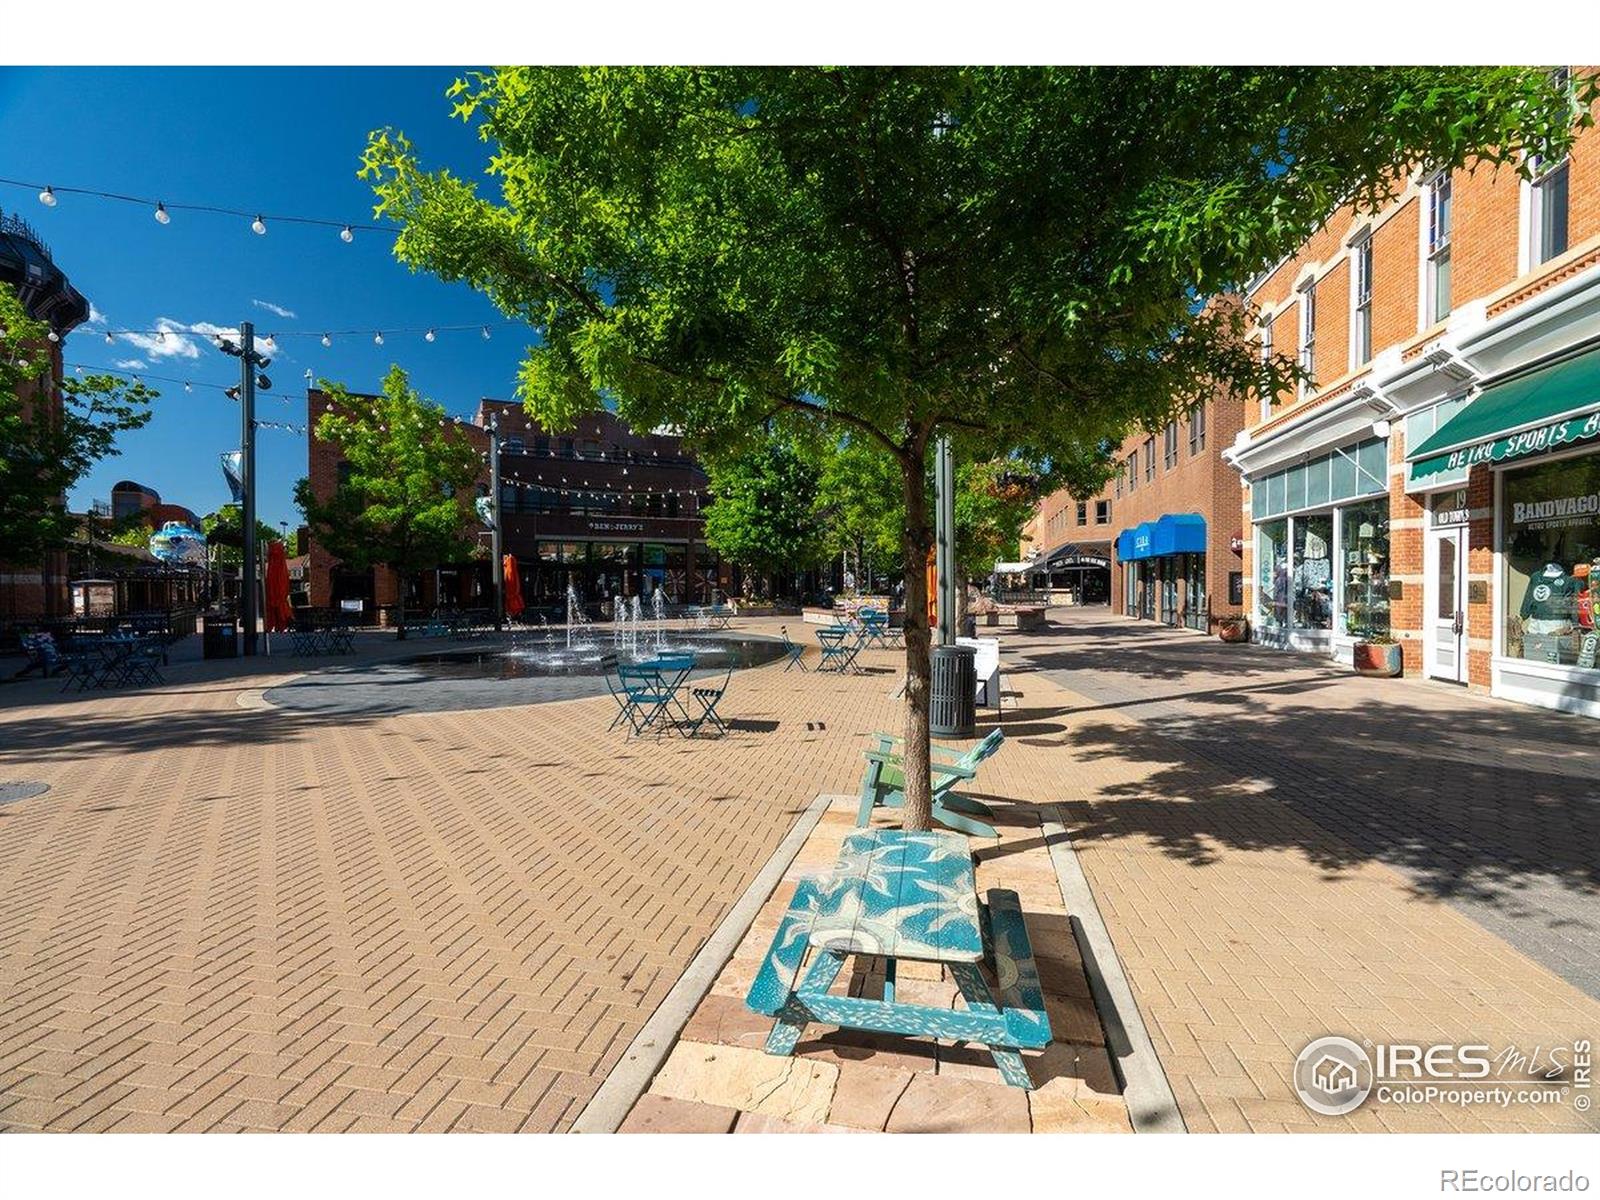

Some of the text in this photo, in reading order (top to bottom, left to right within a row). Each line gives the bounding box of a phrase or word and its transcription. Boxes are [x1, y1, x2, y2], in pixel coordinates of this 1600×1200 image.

[1448, 412, 1600, 469] RETRO SPORTS A
[1456, 490, 1467, 508] 19
[1513, 489, 1600, 524] BANDWAGO
[1546, 519, 1567, 529] SPORTS
[1568, 516, 1593, 527] APPAREL
